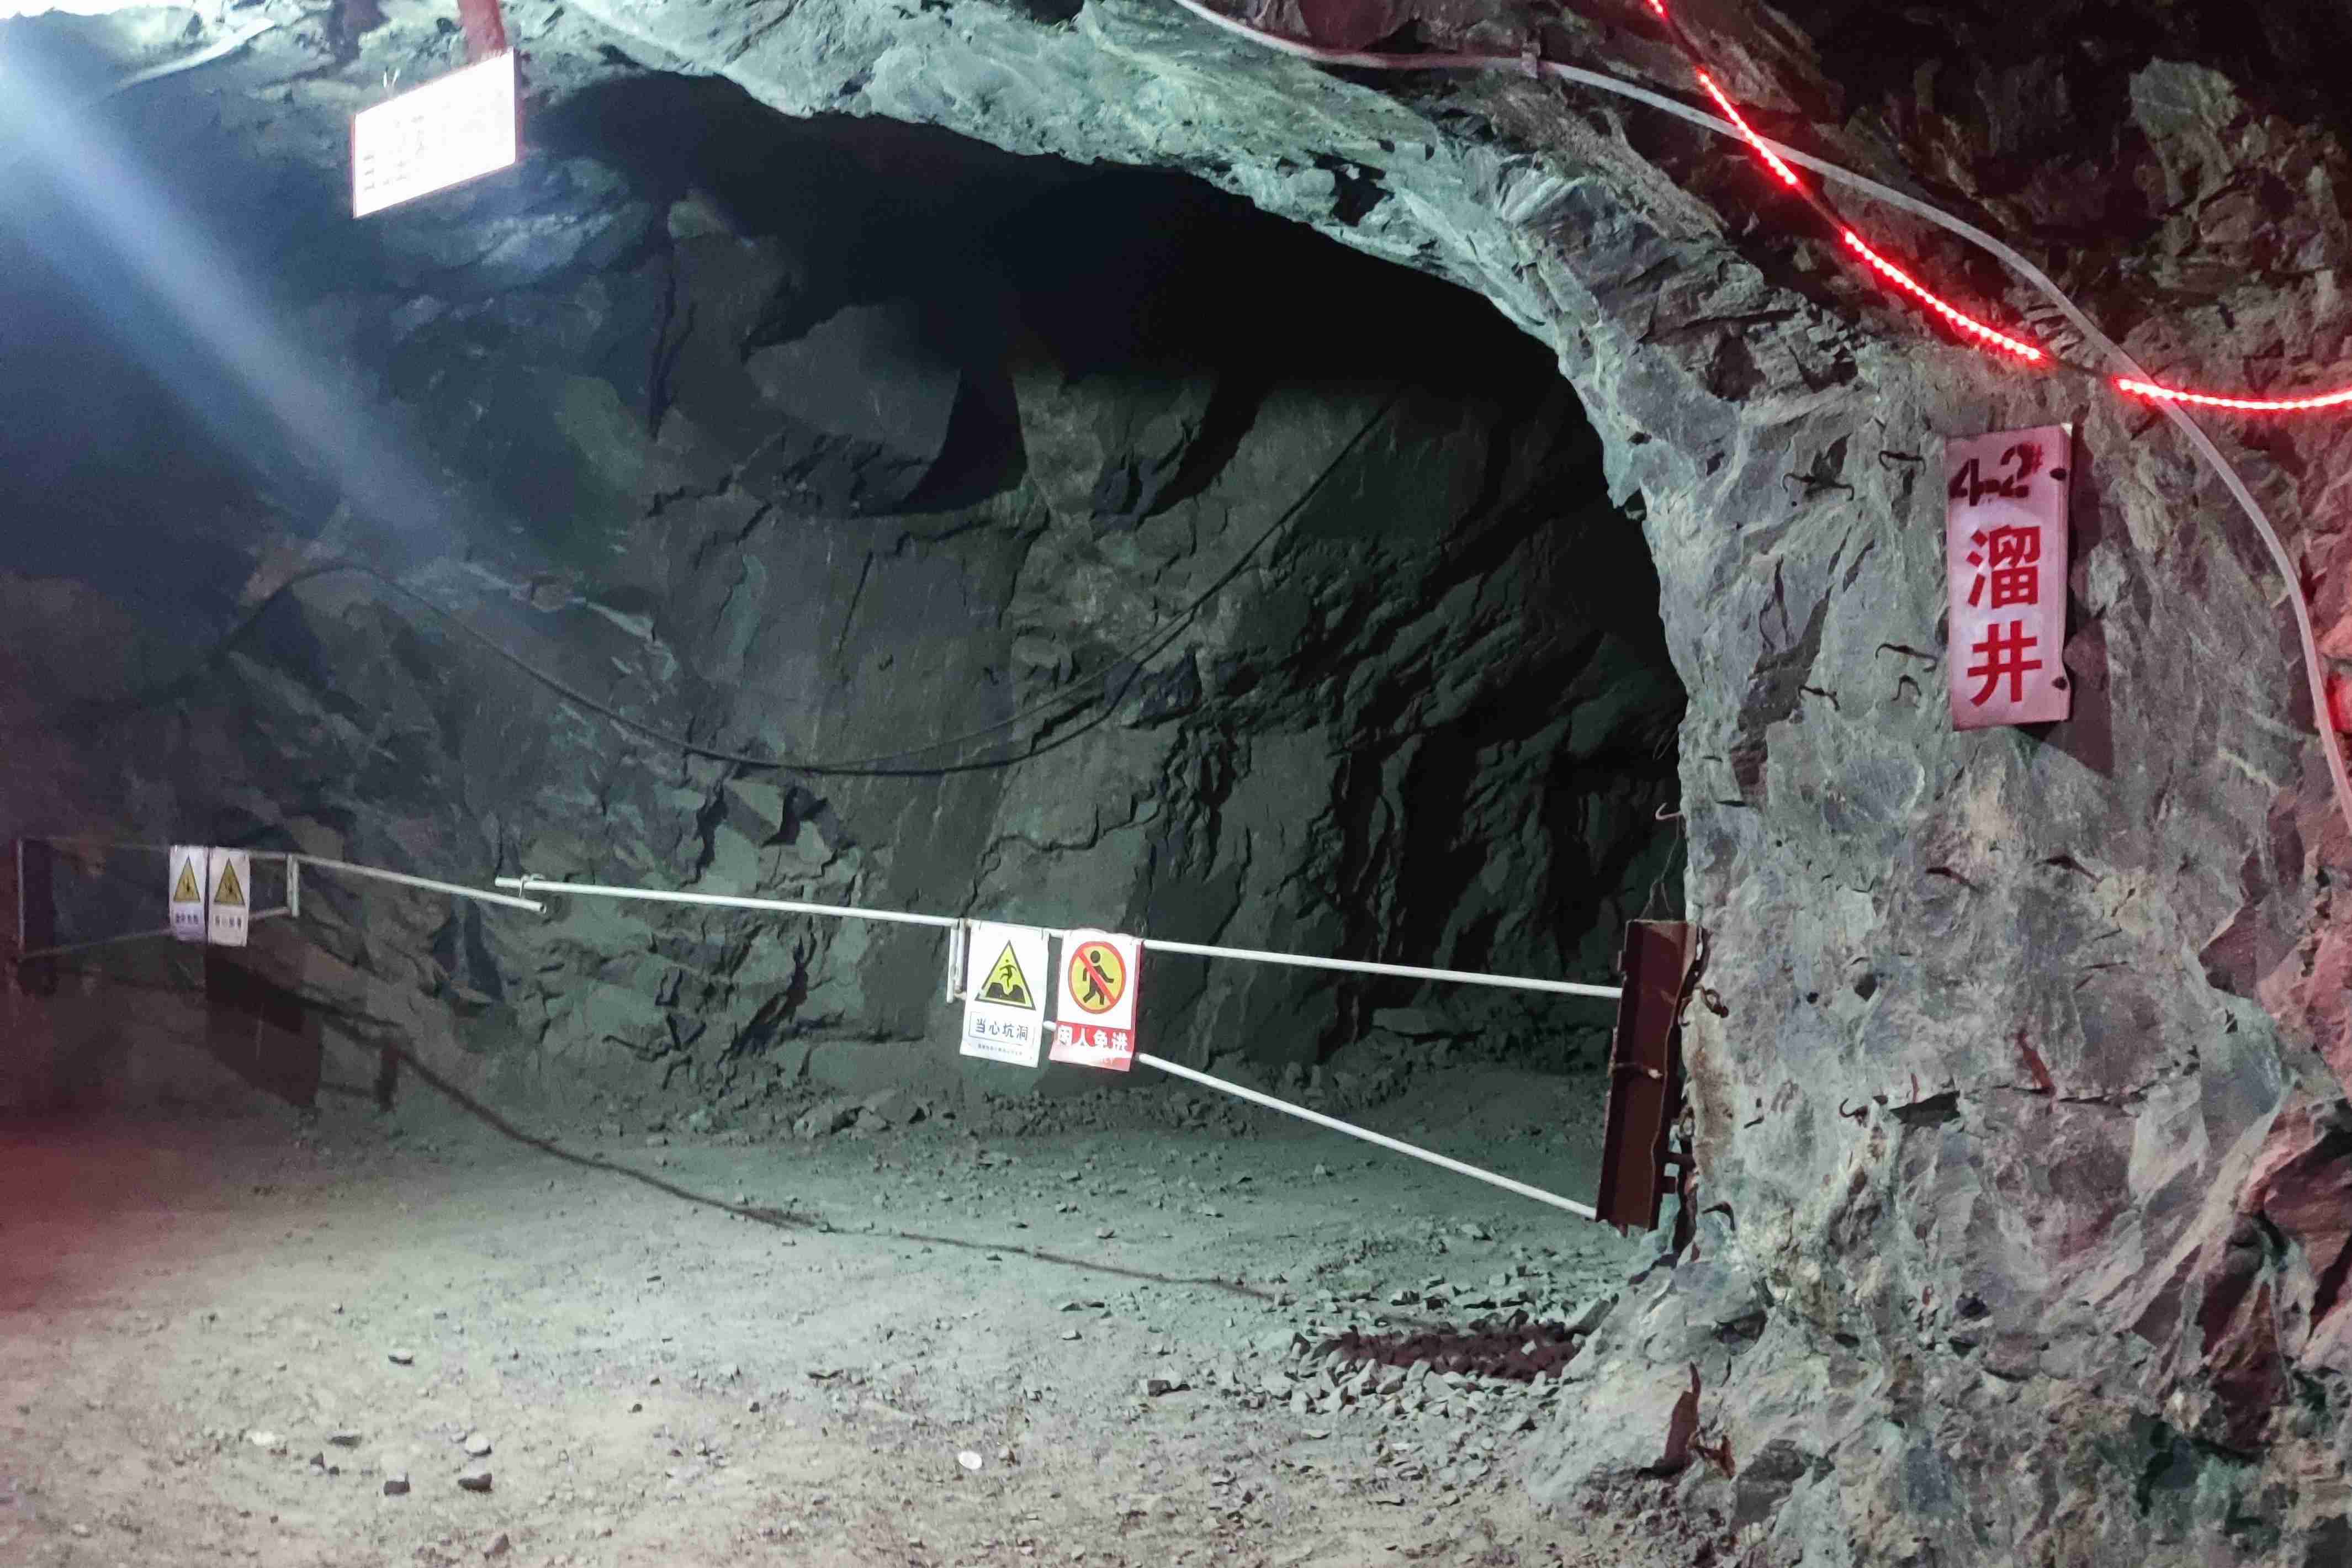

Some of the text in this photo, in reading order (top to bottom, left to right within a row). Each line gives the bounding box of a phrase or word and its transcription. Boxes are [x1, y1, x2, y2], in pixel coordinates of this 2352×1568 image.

[1967, 525, 2042, 707] 溜井
[976, 1018, 1028, 1041] 当心坑洞
